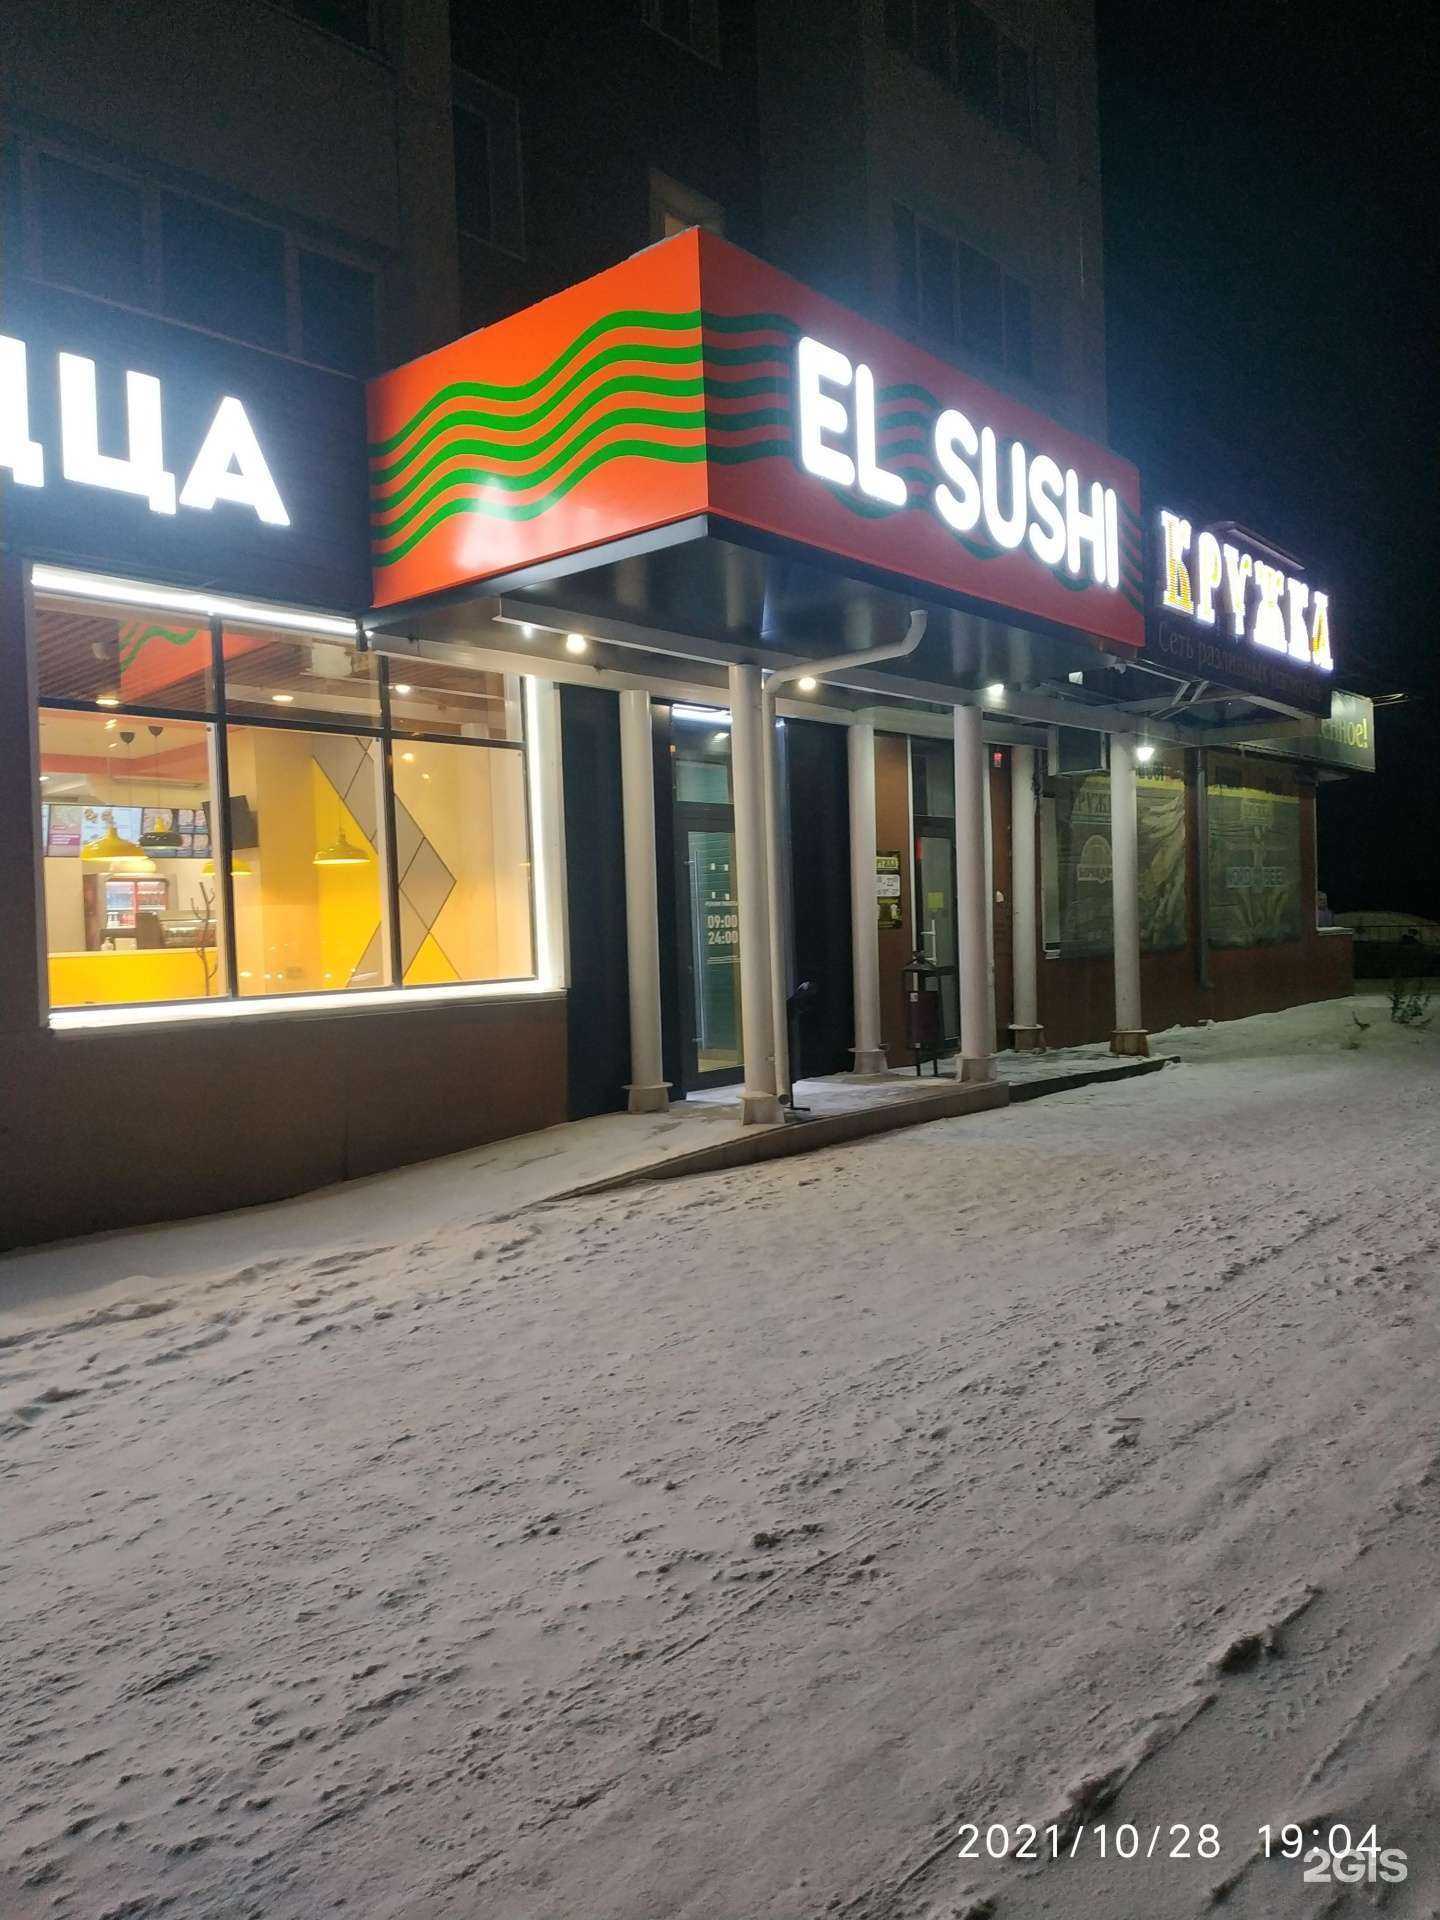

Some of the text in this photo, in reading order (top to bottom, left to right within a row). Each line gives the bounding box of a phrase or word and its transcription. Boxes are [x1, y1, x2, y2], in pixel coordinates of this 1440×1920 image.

[798, 336, 1120, 589] EL SUSHI
[1160, 510, 1335, 672] КРУЖКА
